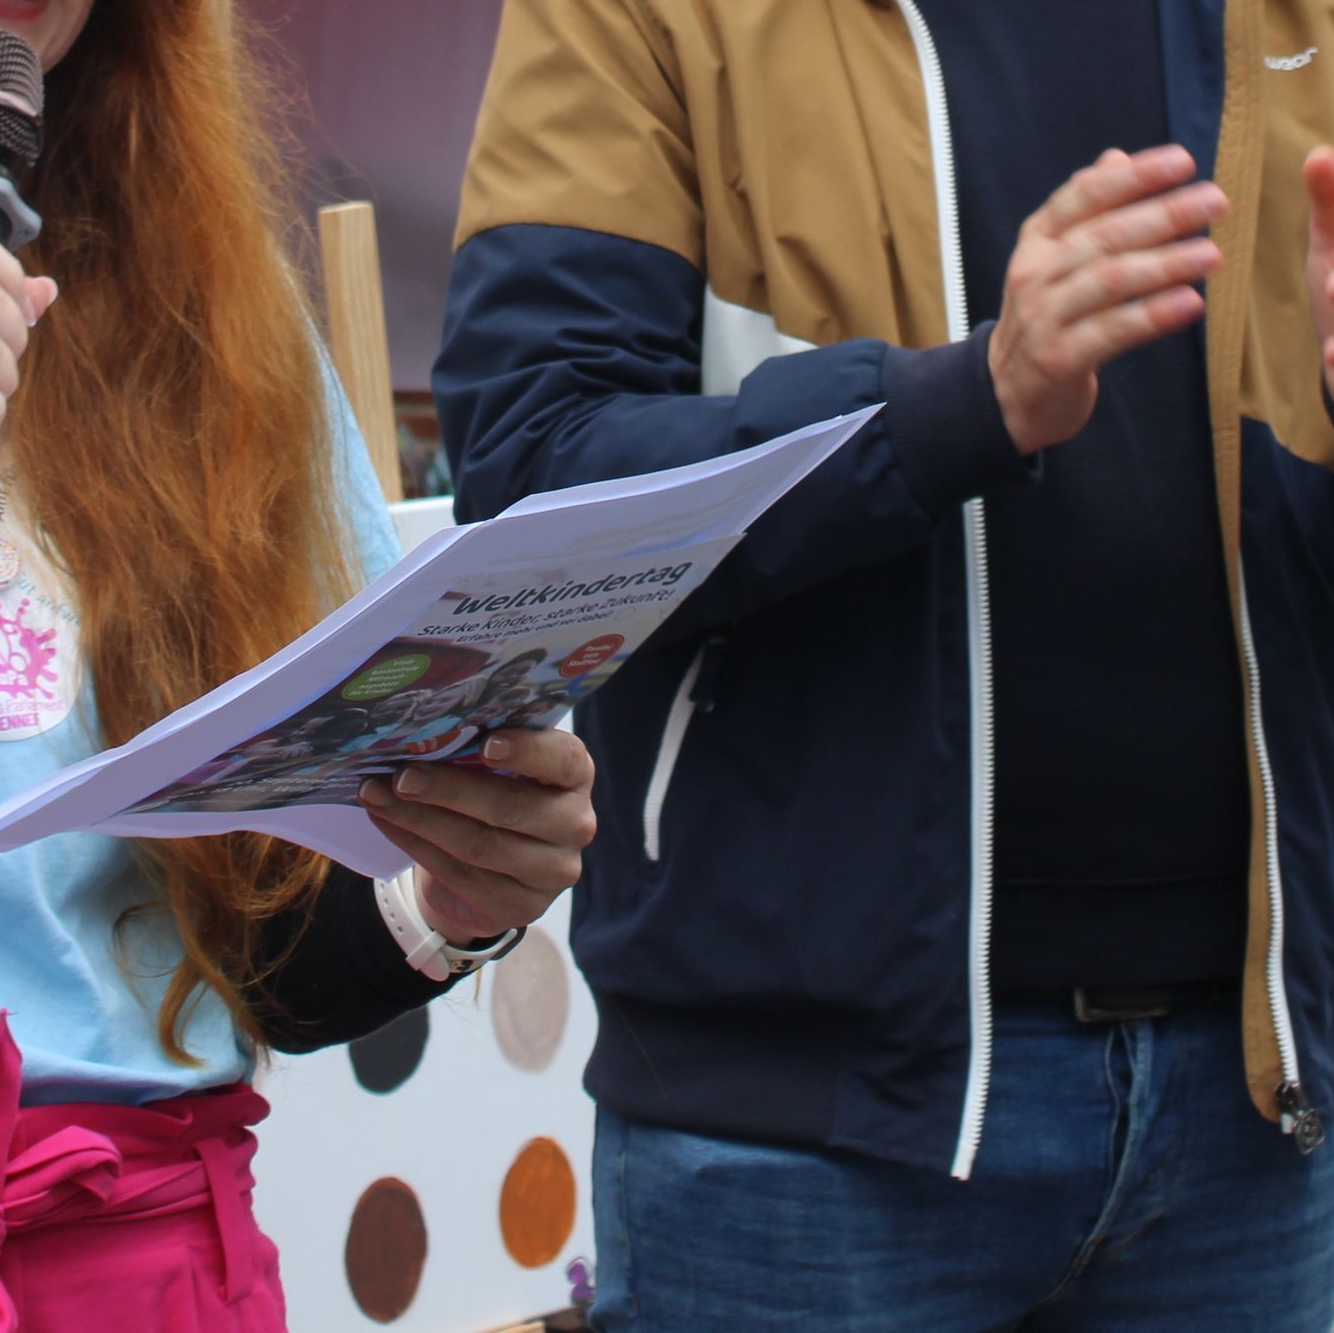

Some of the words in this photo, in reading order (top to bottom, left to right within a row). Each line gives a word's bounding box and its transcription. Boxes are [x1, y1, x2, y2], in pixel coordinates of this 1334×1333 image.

[452, 562, 693, 615] Weltkindertag
[416, 623, 480, 636] Starke
[480, 614, 542, 631] Kinder,
